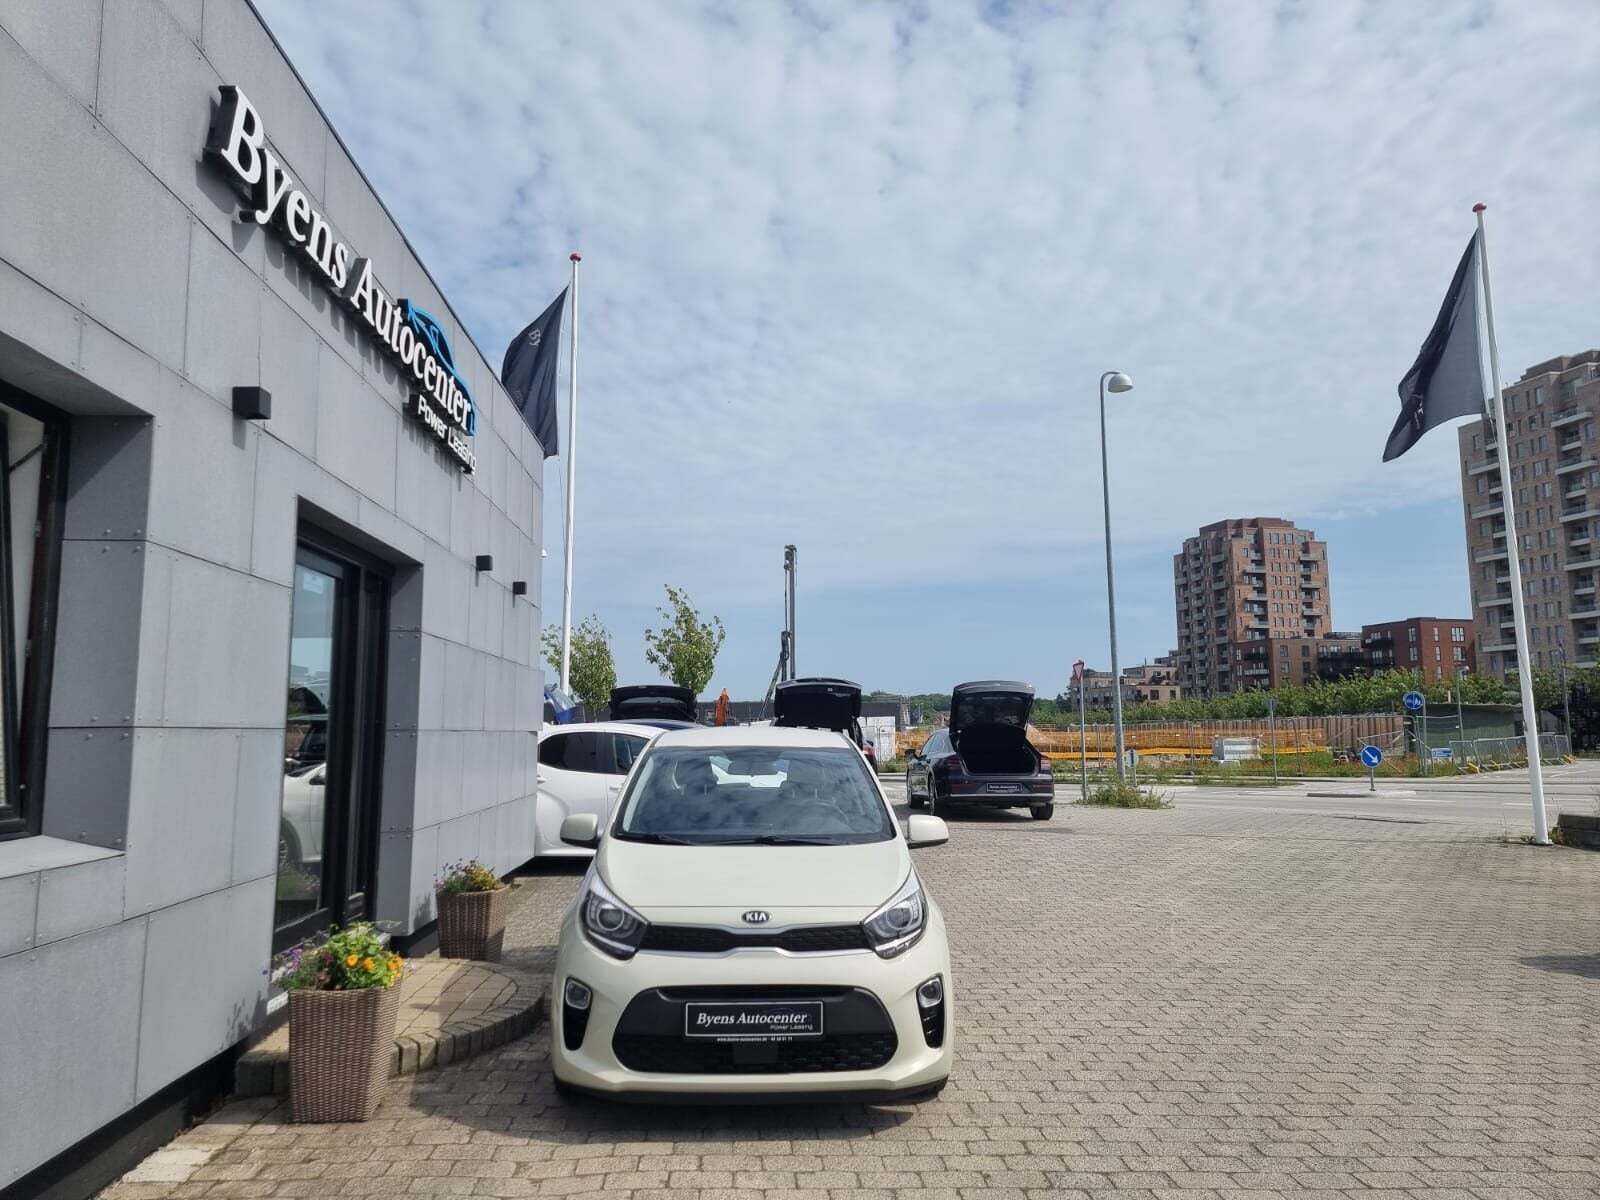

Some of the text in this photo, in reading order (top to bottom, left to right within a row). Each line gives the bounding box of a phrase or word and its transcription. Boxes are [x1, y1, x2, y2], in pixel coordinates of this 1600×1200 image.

[220, 84, 471, 431] Byens Autocenter
[417, 393, 477, 476] Power Leasing
[744, 911, 767, 922] KIA
[696, 1011, 808, 1027] Byens Autocenter
